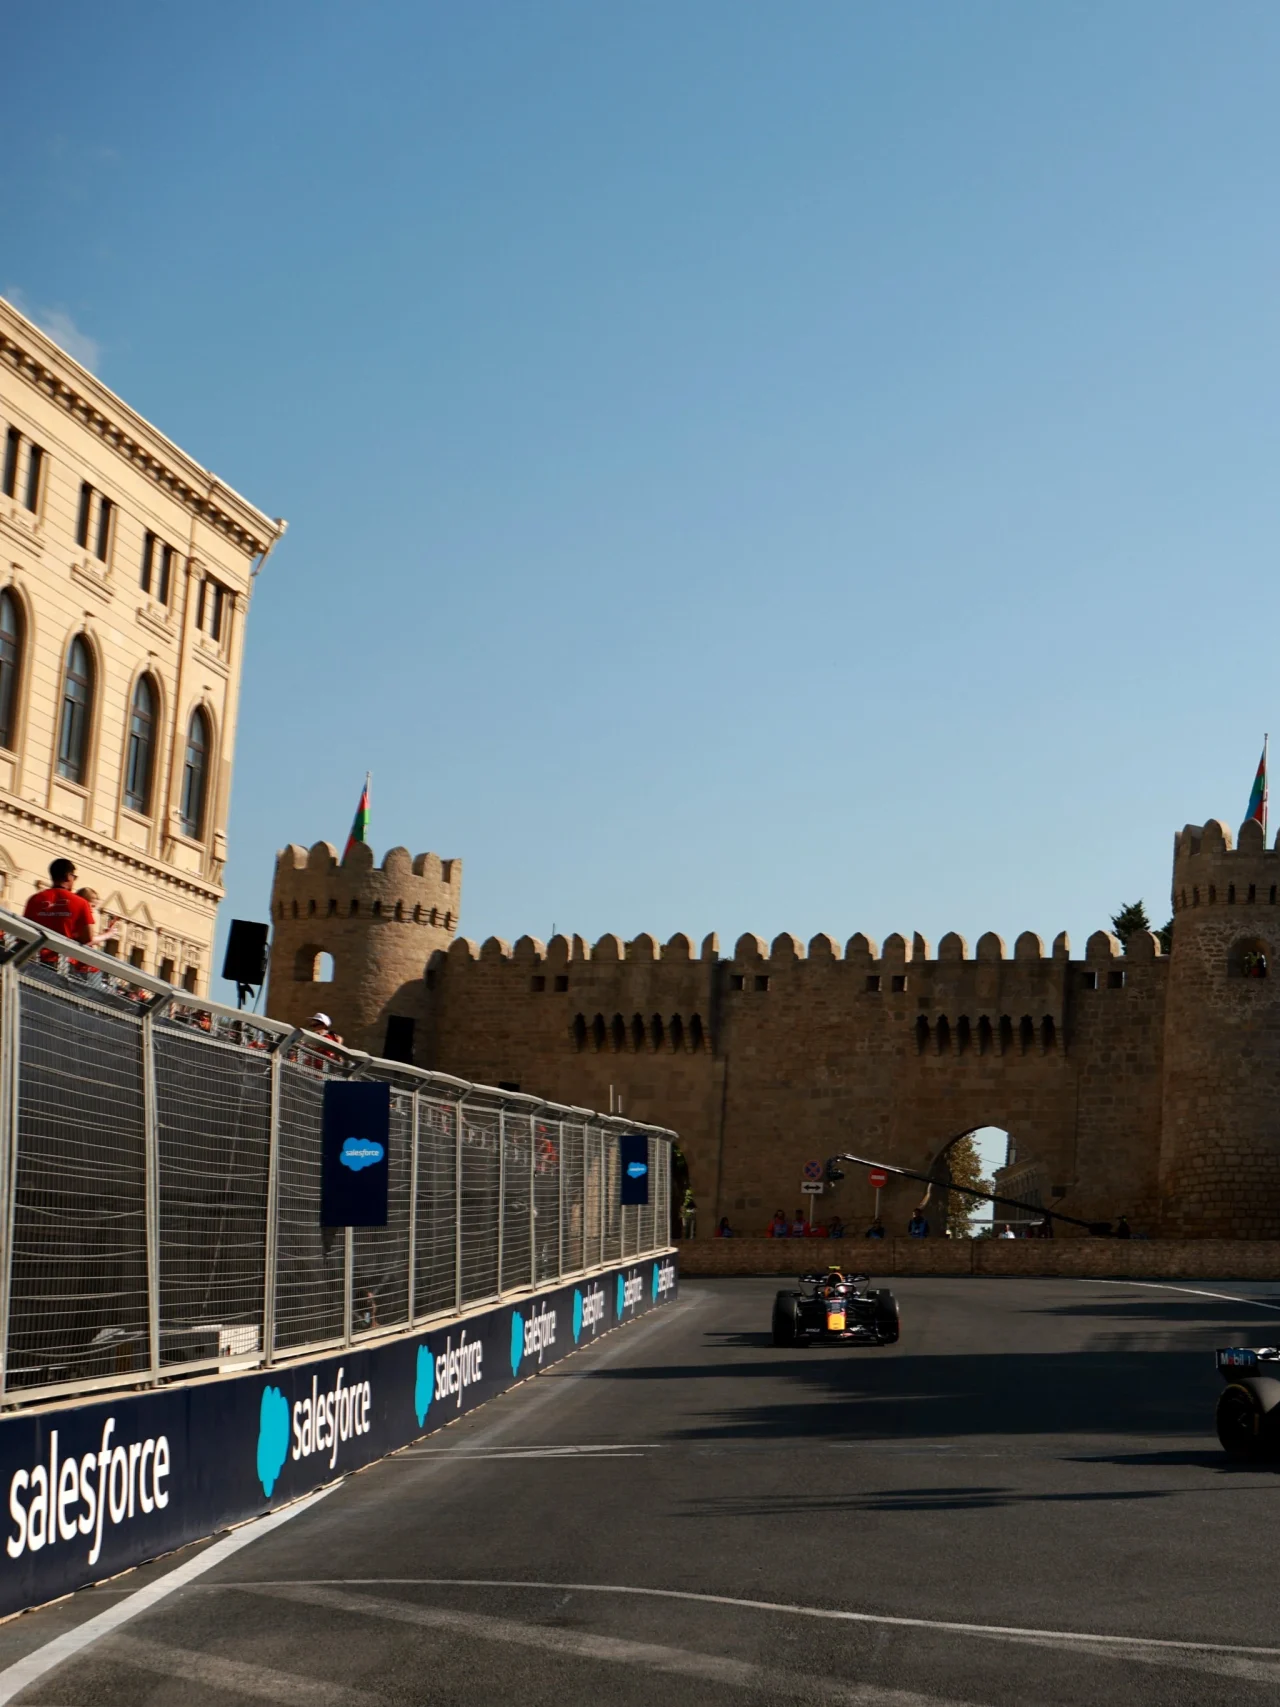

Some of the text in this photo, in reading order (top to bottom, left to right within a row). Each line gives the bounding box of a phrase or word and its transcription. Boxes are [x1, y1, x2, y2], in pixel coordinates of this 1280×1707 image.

[345, 1148, 380, 1159] salesforce
[582, 1281, 604, 1335] salesforce
[624, 1269, 643, 1314] salesforce
[523, 1301, 556, 1365] salesforce
[1220, 1351, 1244, 1367] Mobil
[435, 1329, 482, 1408] salesforce
[292, 1367, 371, 1469] salesforce
[7, 1417, 170, 1566] salesforce
